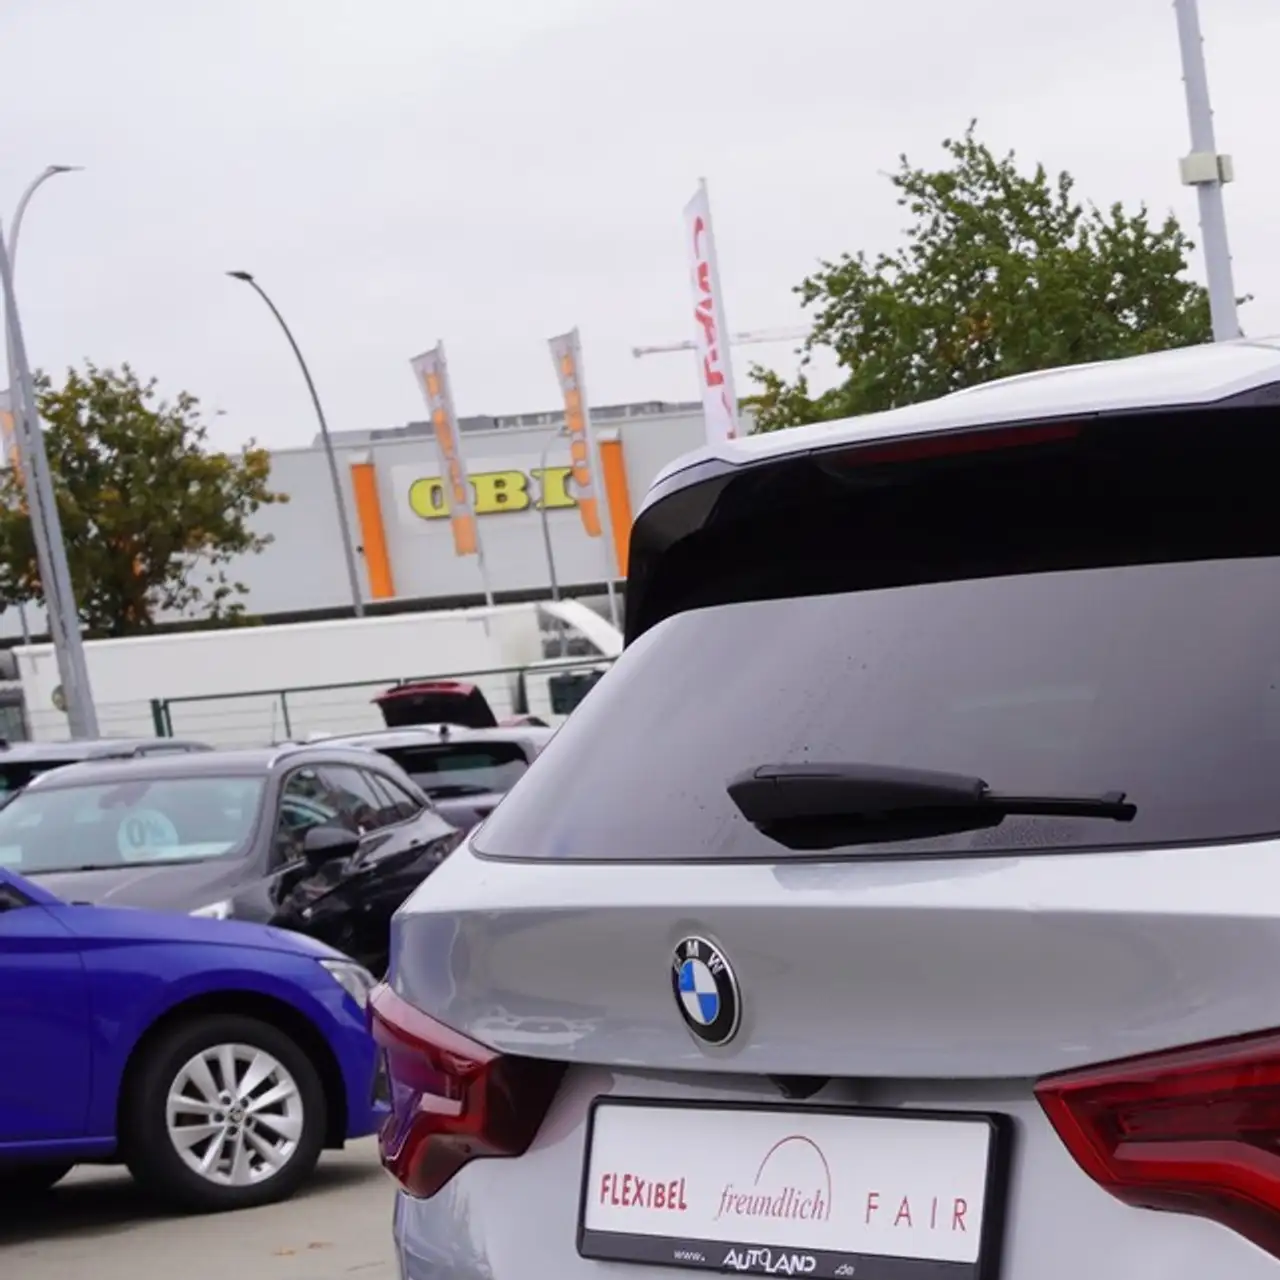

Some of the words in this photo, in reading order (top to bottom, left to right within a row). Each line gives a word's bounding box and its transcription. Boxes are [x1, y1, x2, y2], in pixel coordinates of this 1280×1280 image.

[409, 467, 580, 520] OBI
[600, 1172, 688, 1211] FLEXIBEL
[713, 1182, 825, 1222] freundlich
[722, 1248, 817, 1276] AUTOLAND
